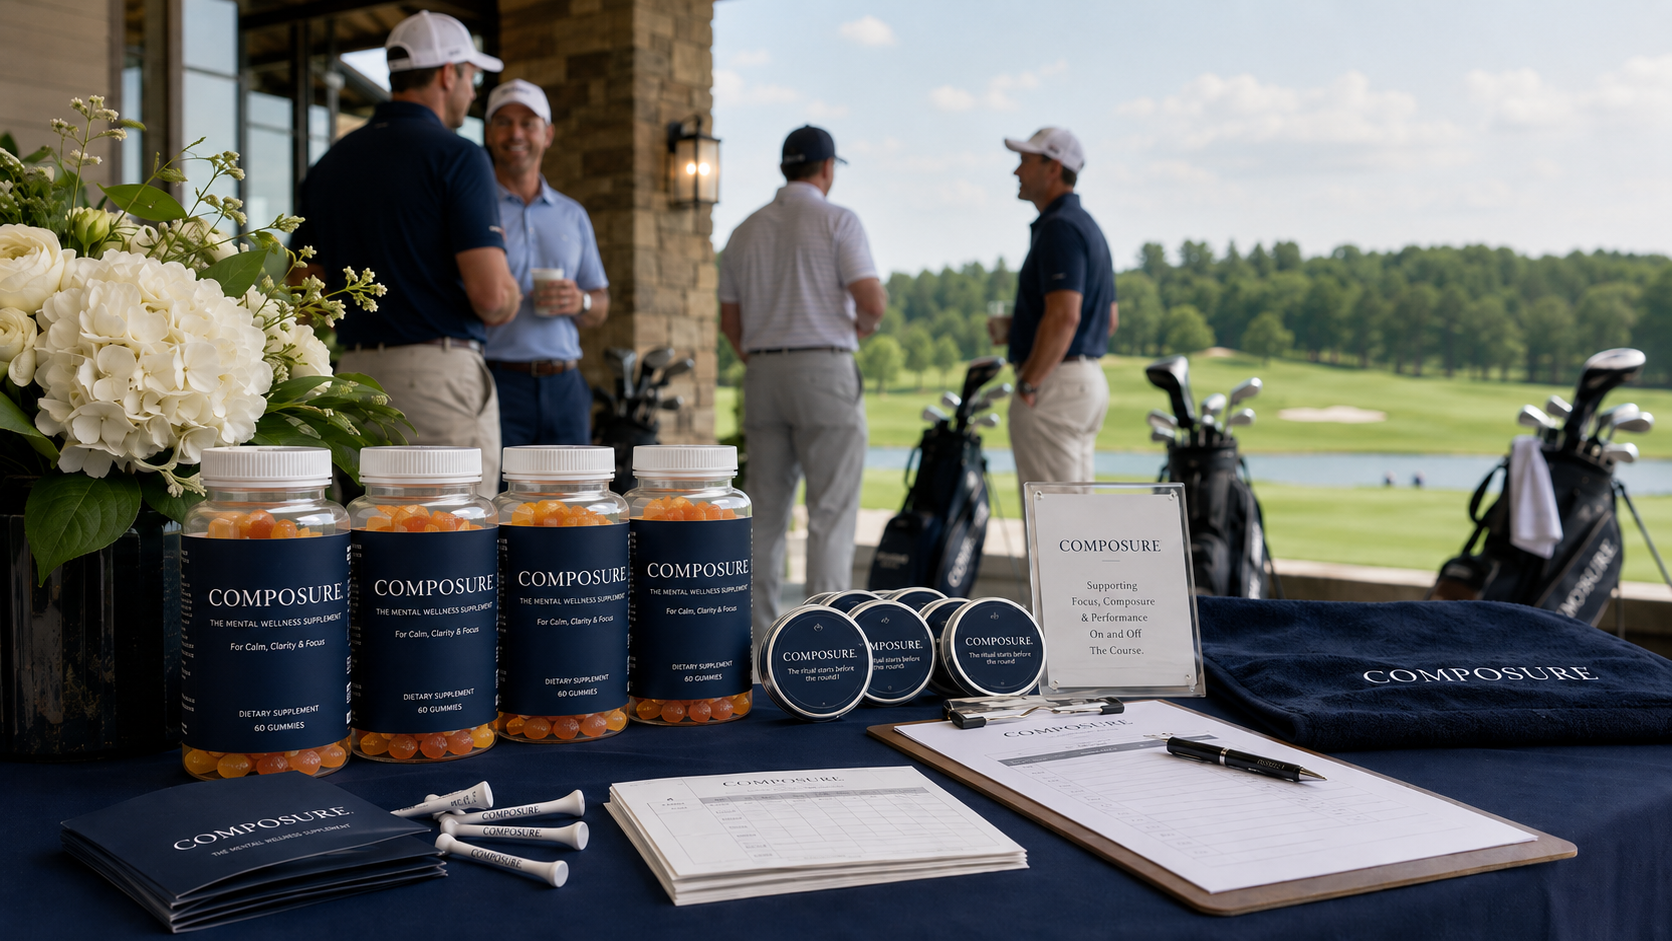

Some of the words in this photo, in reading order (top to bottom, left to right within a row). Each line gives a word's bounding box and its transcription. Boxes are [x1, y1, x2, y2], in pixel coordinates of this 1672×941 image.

[1059, 539, 1162, 553] COMPOSURE
[647, 559, 749, 578] COMPOSURE
[518, 566, 627, 587] COMPOSURE
[650, 588, 661, 596] THE
[662, 588, 688, 596] MENTAL
[689, 587, 720, 596] WELLNESS
[1086, 580, 1138, 592] Supporting
[520, 597, 532, 605] THE
[533, 597, 562, 605] MENTAL
[563, 596, 596, 605] WELLNESS
[1071, 596, 1101, 607] Focus,
[1103, 596, 1155, 608] Composure
[376, 608, 390, 616] THE
[391, 608, 421, 616] MENTAL
[423, 606, 459, 616] WELLNESS
[666, 606, 677, 615] For
[678, 606, 696, 616] Calm,
[696, 605, 717, 616] Clarity
[717, 605, 722, 613] &
[723, 605, 738, 613] Focus
[210, 619, 224, 628] THE
[225, 619, 258, 628] MENTAL
[260, 618, 302, 628] WELLNESS
[303, 612, 342, 625] SUPPLEMENT
[536, 618, 549, 626] For
[549, 617, 570, 627] Calm,
[570, 616, 592, 626] Clarity
[592, 615, 598, 624] &
[599, 614, 614, 623] Focus
[1081, 612, 1089, 623] &
[1091, 612, 1148, 622] Performance
[395, 629, 407, 638] For
[408, 628, 430, 639] Calm,
[431, 627, 455, 638] Clarity
[456, 627, 461, 636] &
[462, 625, 480, 635] Focus
[1089, 629, 1104, 639] On
[1106, 629, 1124, 639] and
[1126, 628, 1142, 639] Off
[230, 642, 244, 652] For
[245, 642, 269, 652] Calm,
[270, 640, 297, 652] Clarity
[298, 640, 304, 649] &
[306, 638, 326, 649] Focus
[870, 640, 923, 651] MPOSURE.
[1089, 645, 1107, 655] The
[1109, 645, 1144, 655] Course.
[1013, 650, 1032, 658] before
[671, 663, 698, 671] DIETARY
[787, 667, 800, 676] The
[835, 664, 855, 673] before
[545, 677, 572, 686] DIETARY
[573, 673, 610, 685] SUPPLEMENT
[684, 675, 694, 683] 60
[694, 673, 723, 682] GUMMIES
[805, 674, 817, 682] the
[1363, 666, 1599, 684] COMPOSURE
[403, 692, 433, 701] DIETARY
[434, 687, 475, 700] SUPPLEMENT
[557, 690, 567, 698] 60
[568, 687, 598, 697] GUMMIES
[239, 709, 271, 718] DIETARY
[273, 704, 320, 717] SUPPLEMENT
[417, 706, 428, 714] 60
[429, 703, 463, 713] GUMMIES
[254, 723, 265, 732] 60
[267, 721, 305, 732] GUMMIES
[173, 806, 354, 851] COMPOSURE.
[482, 826, 543, 838] COMPOSURE.
[211, 849, 229, 857] THE
